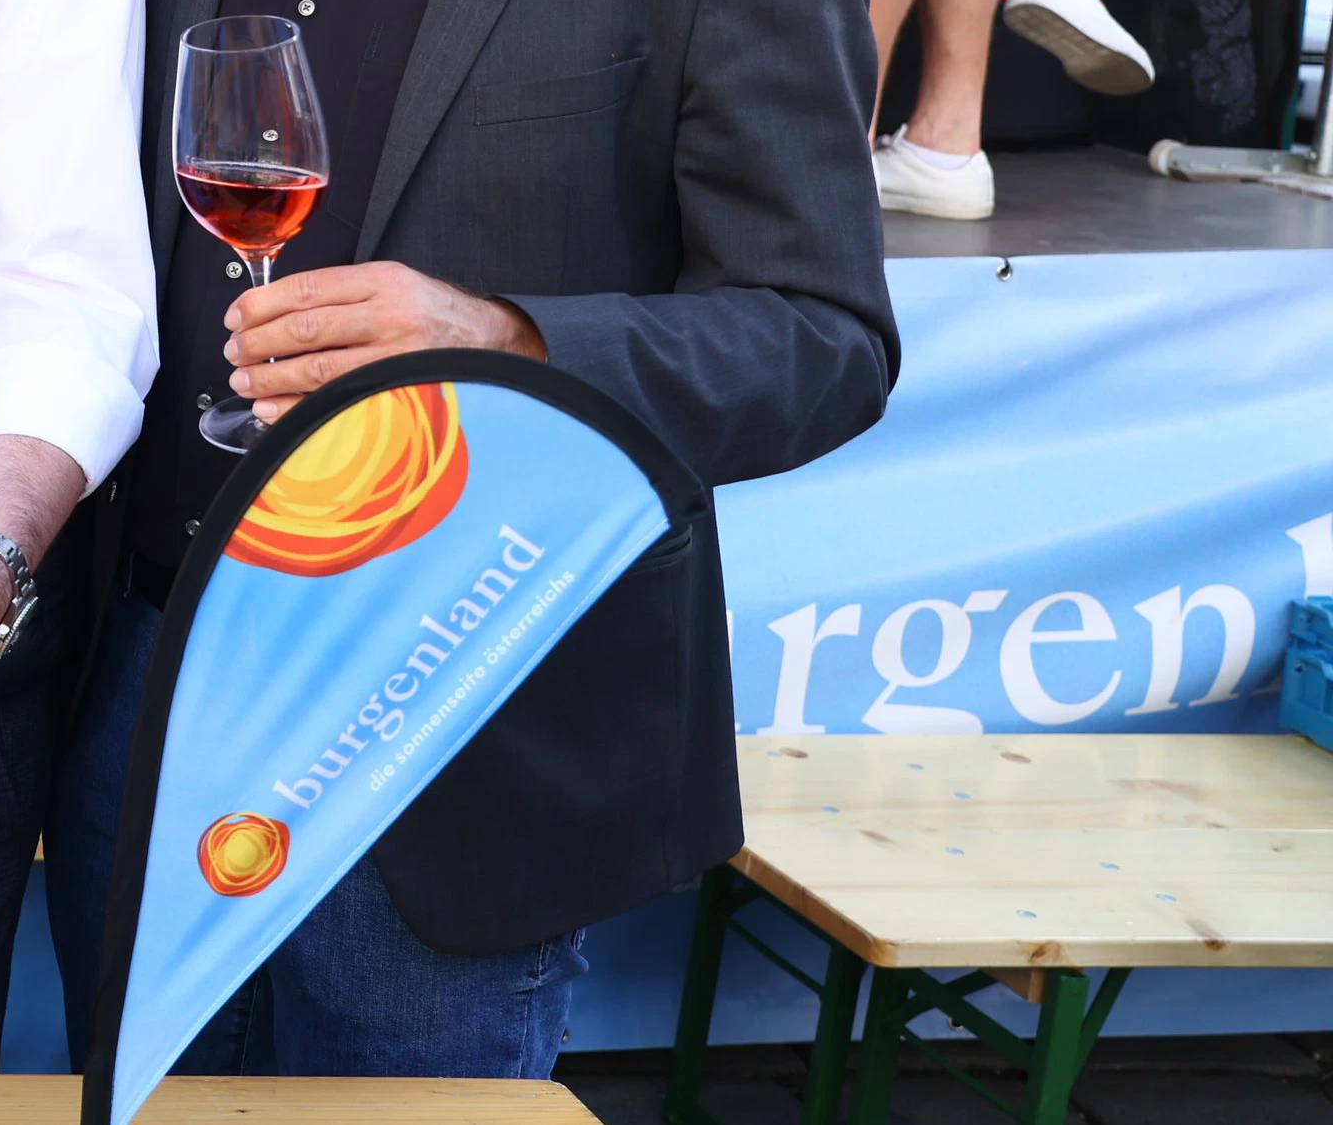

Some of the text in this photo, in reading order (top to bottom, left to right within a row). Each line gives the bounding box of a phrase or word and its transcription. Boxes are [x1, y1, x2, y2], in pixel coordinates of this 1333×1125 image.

[272, 524, 546, 810] burgenland
[368, 569, 576, 792] die sonnenseite österreichs
[727, 513, 1333, 735] rgen
